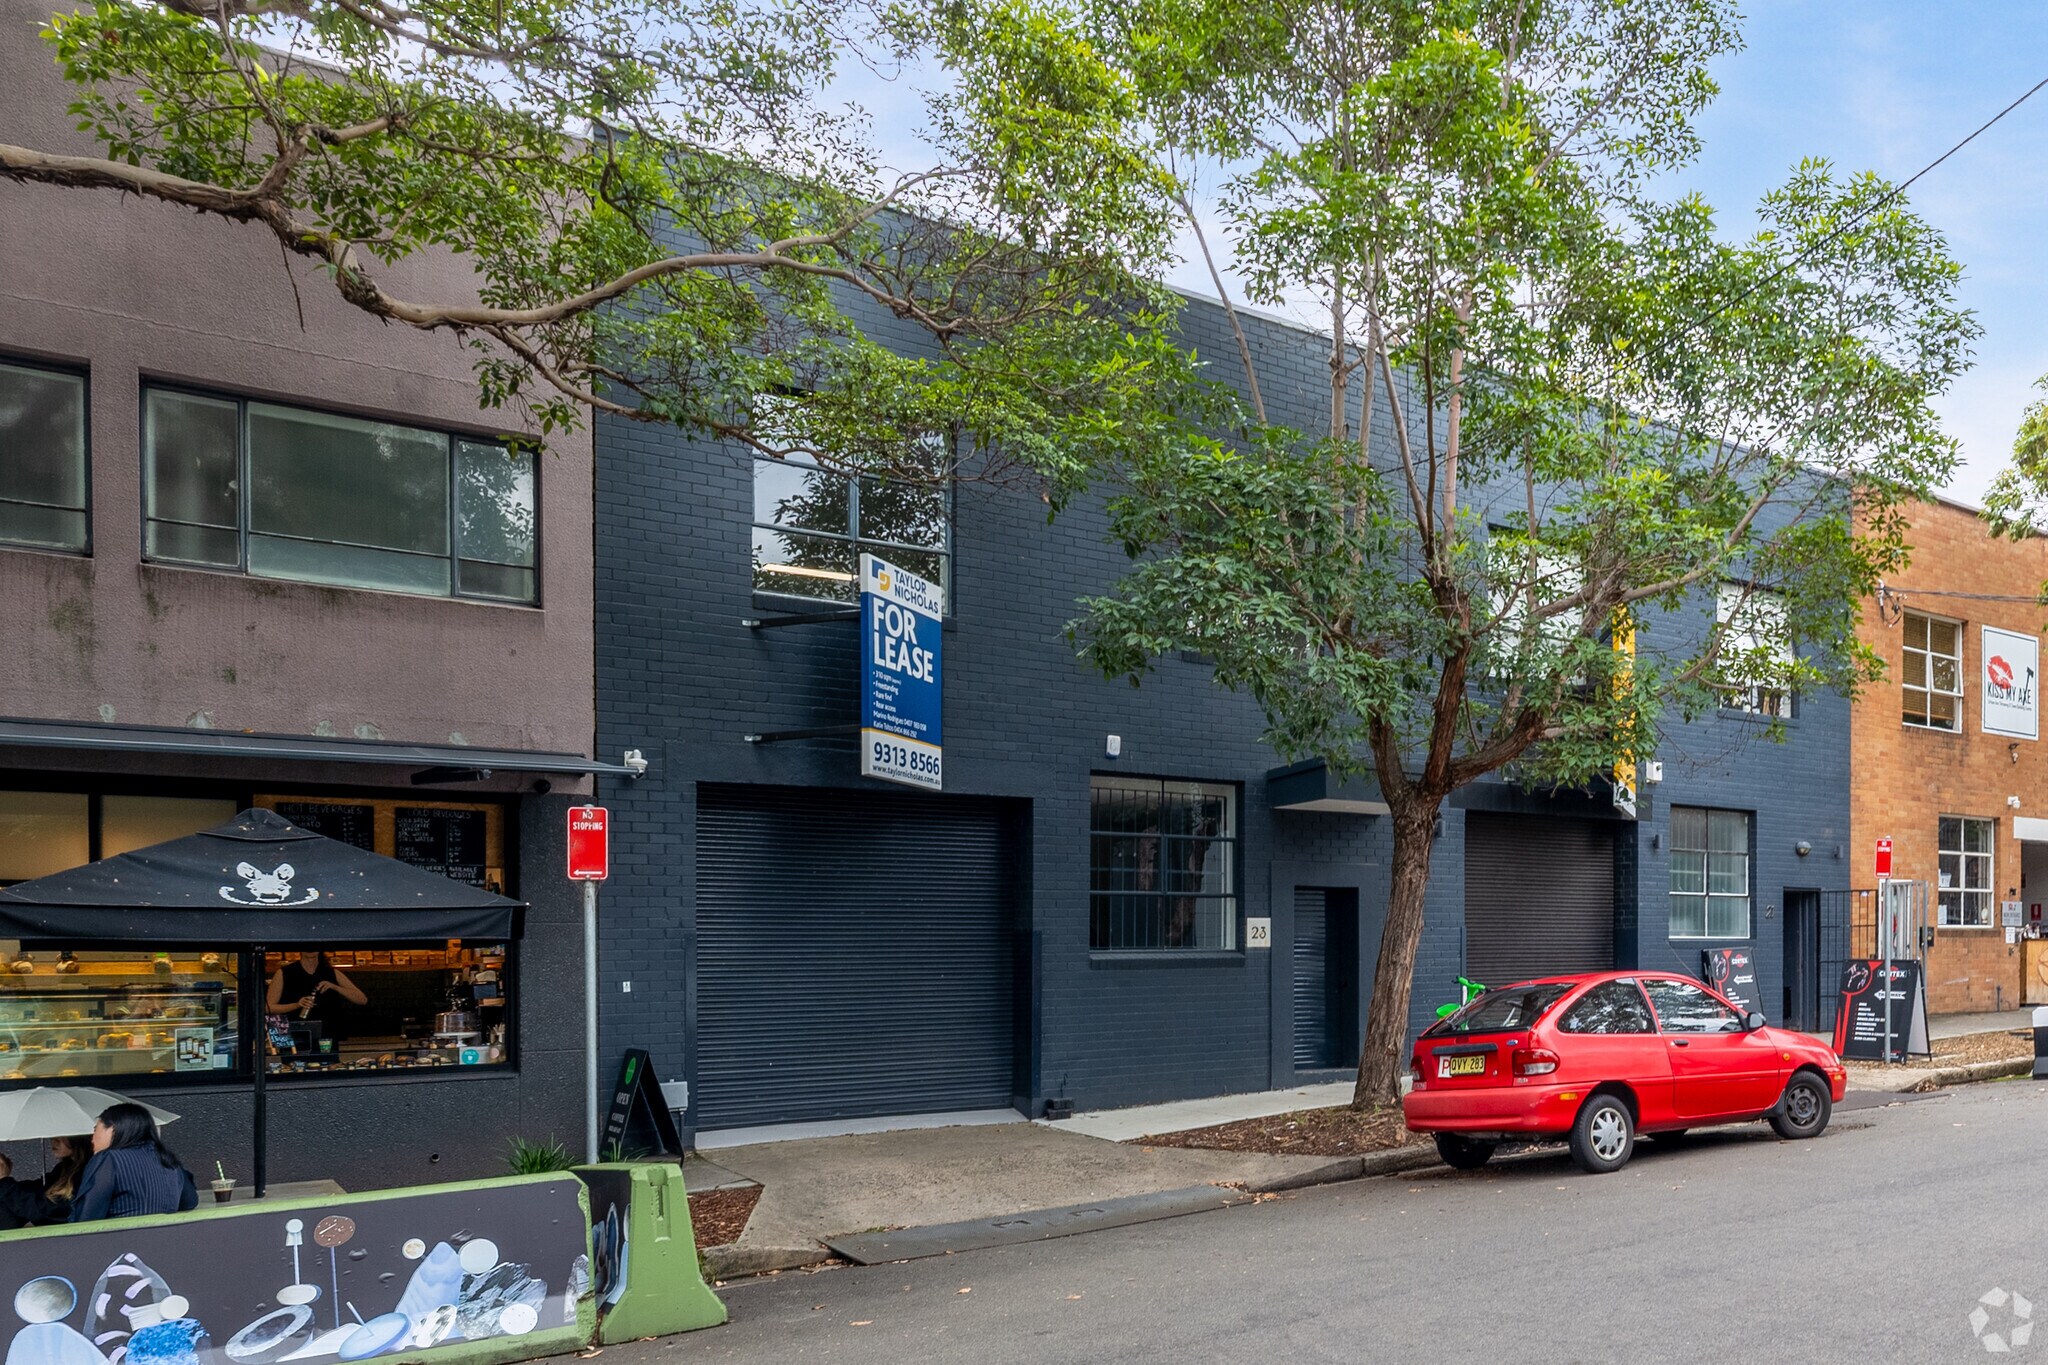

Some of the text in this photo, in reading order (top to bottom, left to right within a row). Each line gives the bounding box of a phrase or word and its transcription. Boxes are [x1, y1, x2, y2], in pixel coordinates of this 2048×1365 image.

[894, 569, 927, 595] TAYLOR
[894, 584, 939, 614] NICHOLAS
[873, 597, 918, 645] FOR
[874, 631, 934, 684] LEASE
[1987, 681, 2031, 705] KISS MY AXE
[873, 741, 940, 776] 9313 8566
[872, 764, 941, 786] www.taylornicholas.com.au
[308, 804, 363, 815] BEVERAGES
[582, 811, 594, 820] NO
[572, 821, 604, 831] STOPPING
[1251, 926, 1267, 939] 23
[1442, 1059, 1450, 1074] P
[1470, 1056, 1484, 1070] 283
[616, 1092, 631, 1105] OPEN
